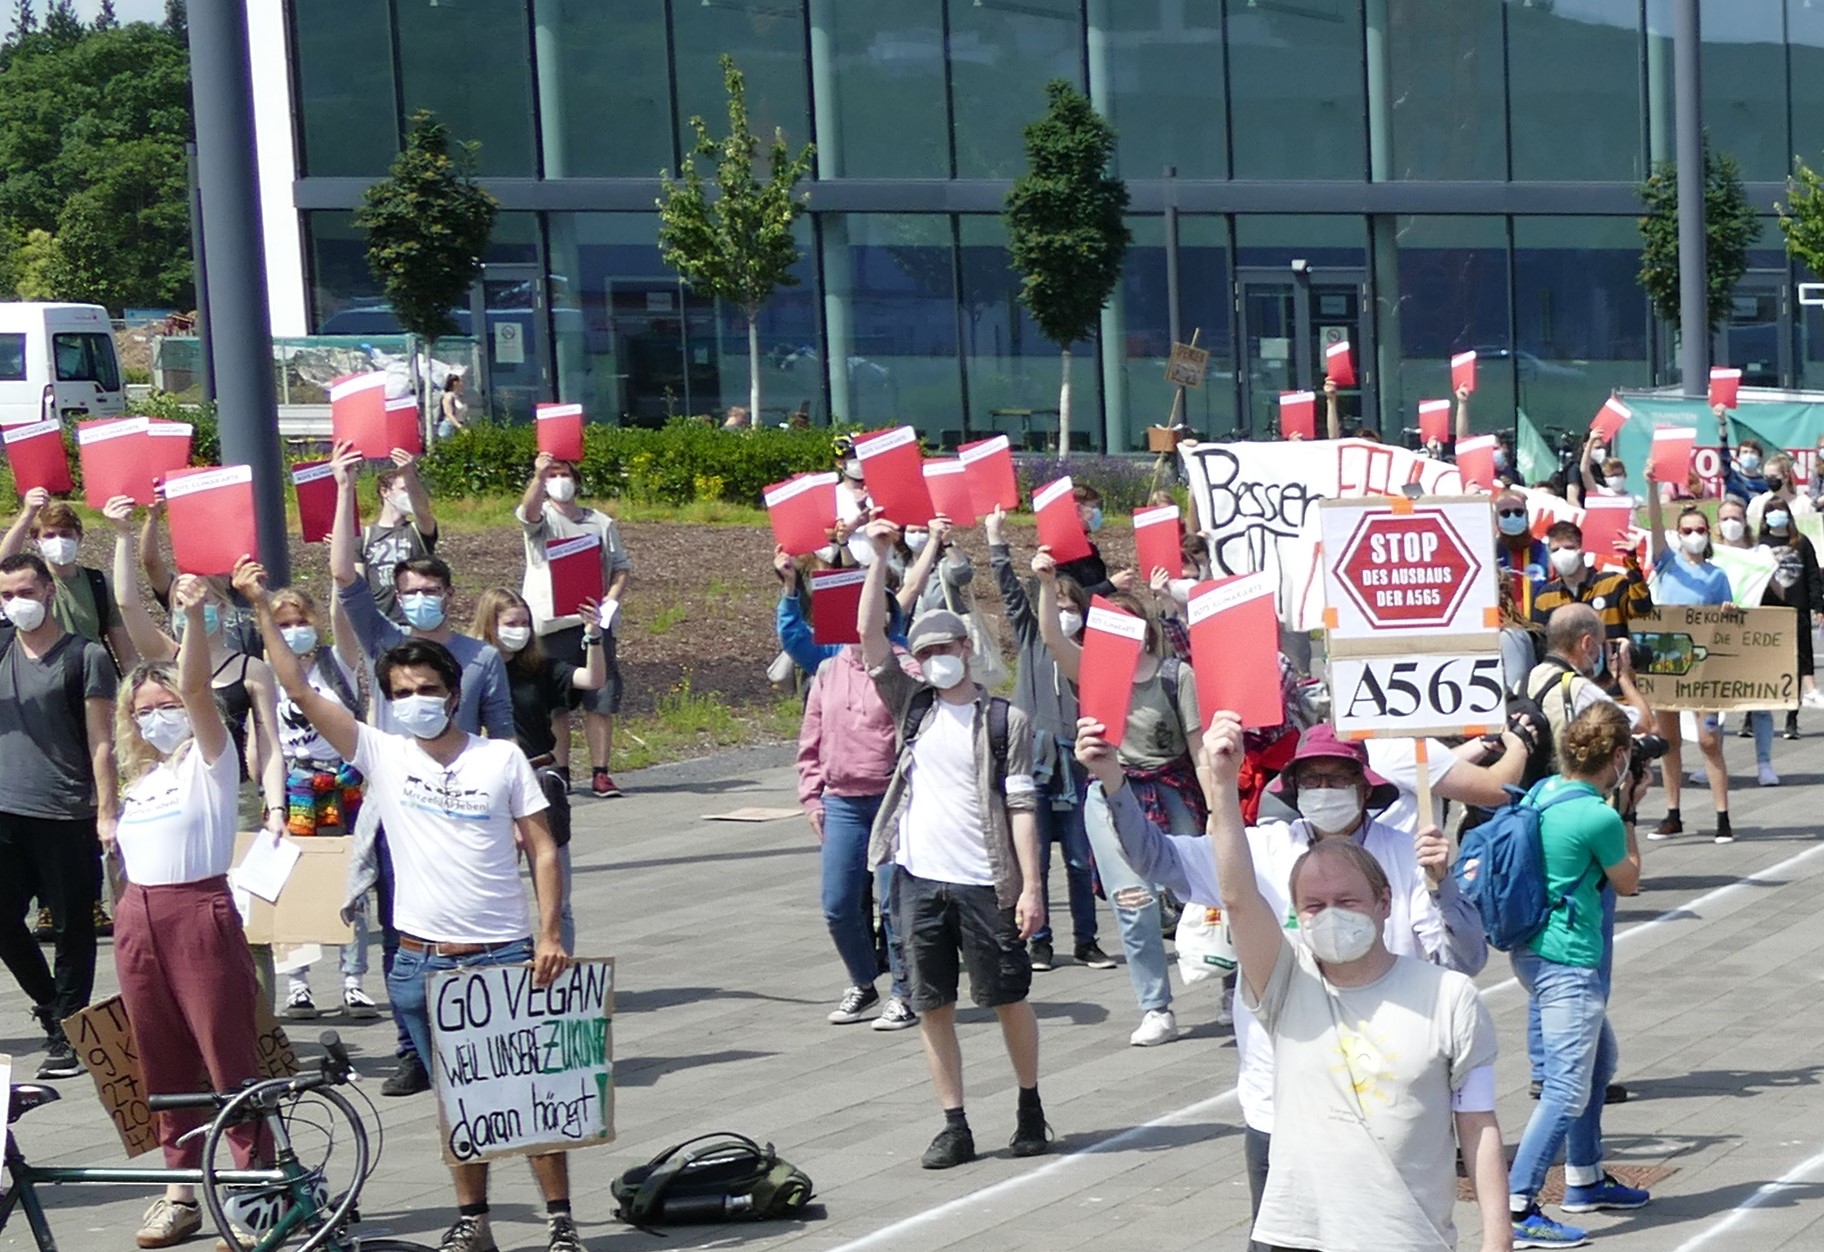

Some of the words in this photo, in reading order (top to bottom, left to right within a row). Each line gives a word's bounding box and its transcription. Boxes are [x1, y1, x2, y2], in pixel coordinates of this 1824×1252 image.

[1191, 448, 1326, 529] Besser
[1370, 532, 1438, 564] STOP
[1362, 569, 1388, 586] DES
[1391, 567, 1452, 584] AUSBAUS
[1376, 590, 1403, 607] DER
[1406, 589, 1441, 606] A565
[1685, 607, 1748, 625] BEKOMMT
[1714, 632, 1731, 645] DIE
[1742, 631, 1784, 646] ERDE
[1342, 658, 1503, 718] A565
[1675, 673, 1793, 703] IMPFTERMIN?
[437, 973, 492, 1033] GO
[503, 962, 608, 1020] VEGAN
[438, 1038, 489, 1088] WEIL
[449, 1098, 523, 1162] daran
